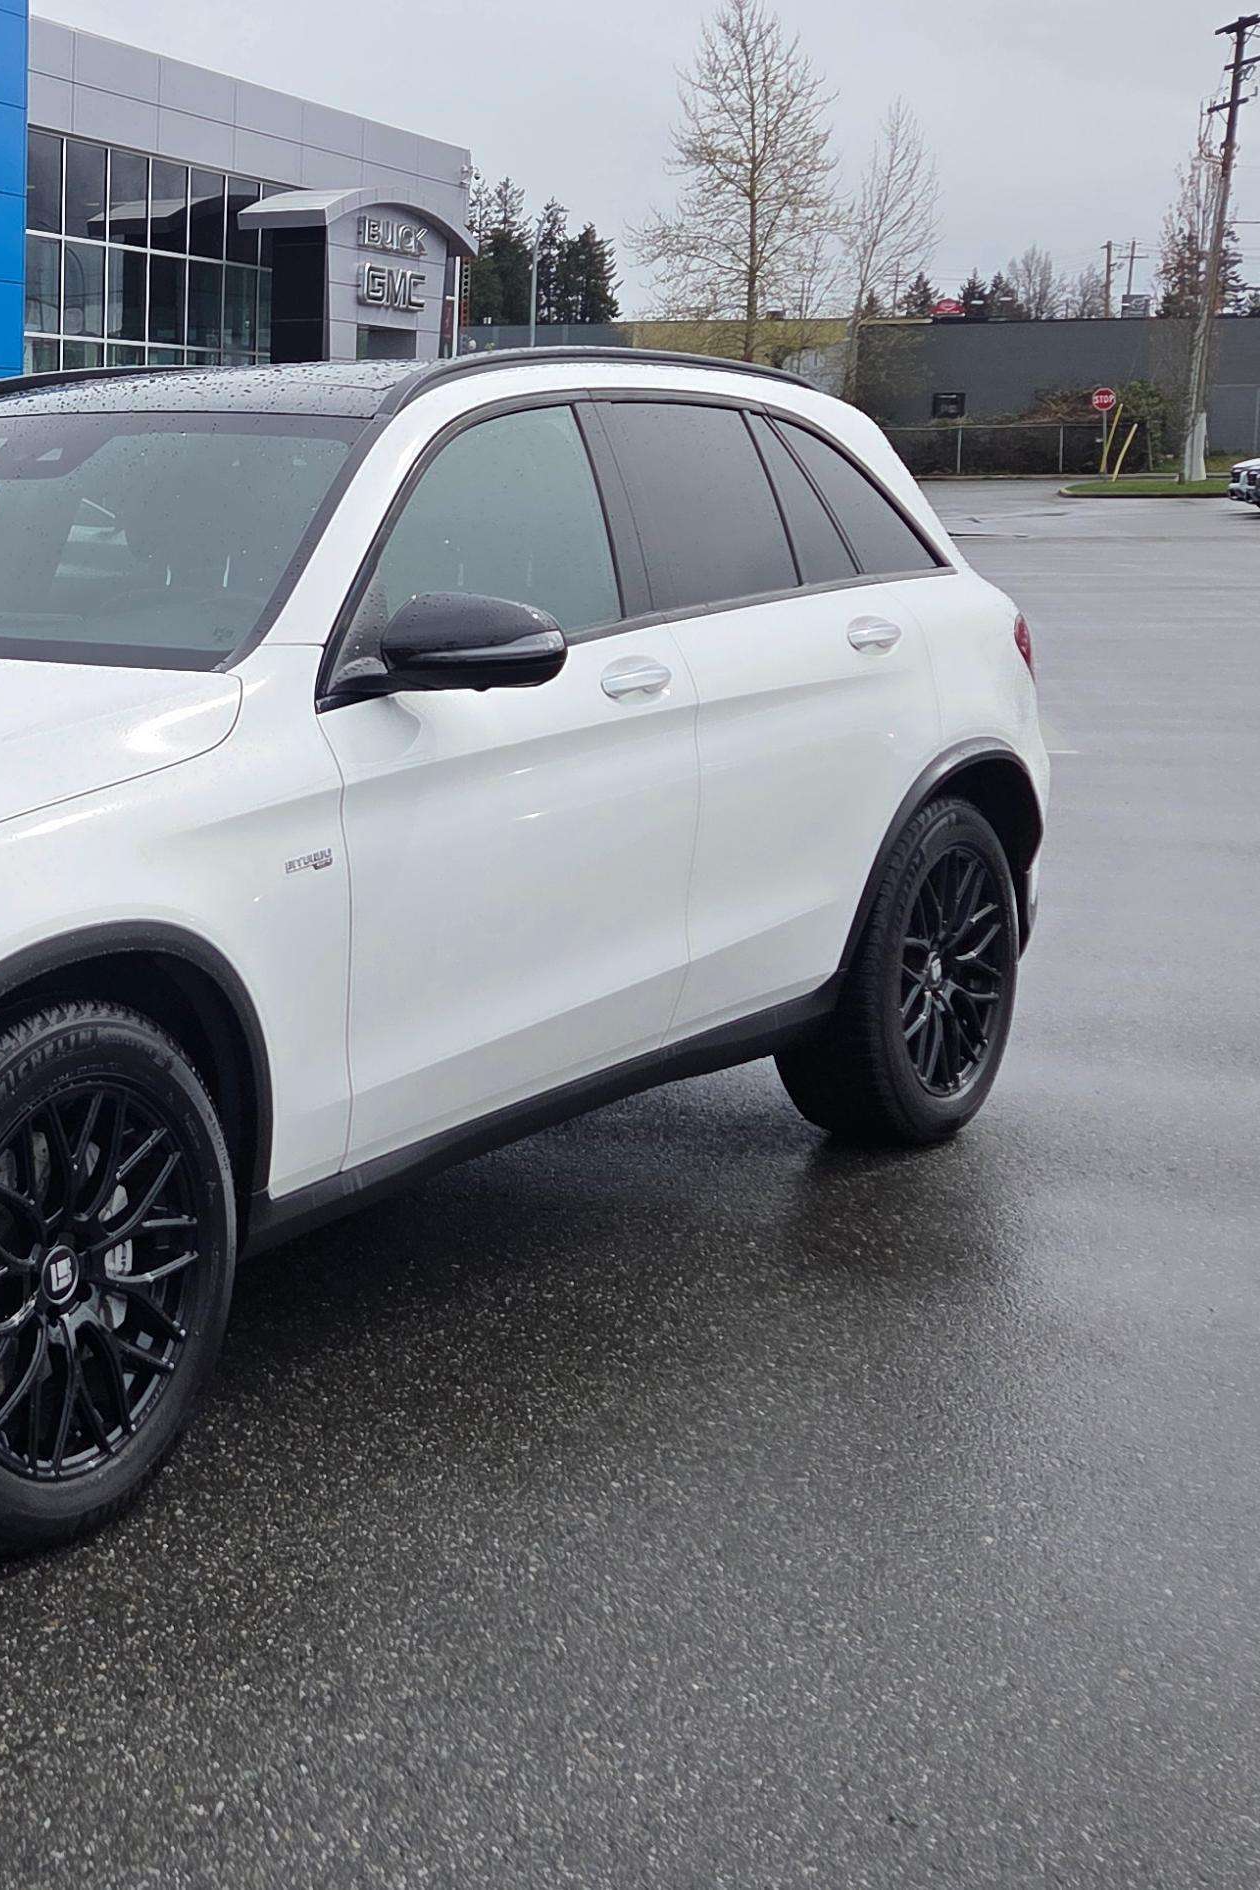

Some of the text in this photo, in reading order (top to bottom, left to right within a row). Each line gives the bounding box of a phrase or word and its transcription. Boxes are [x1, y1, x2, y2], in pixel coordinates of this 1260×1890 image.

[360, 216, 428, 255] BUICK
[359, 263, 426, 311] GMC
[1093, 394, 1115, 404] STOP
